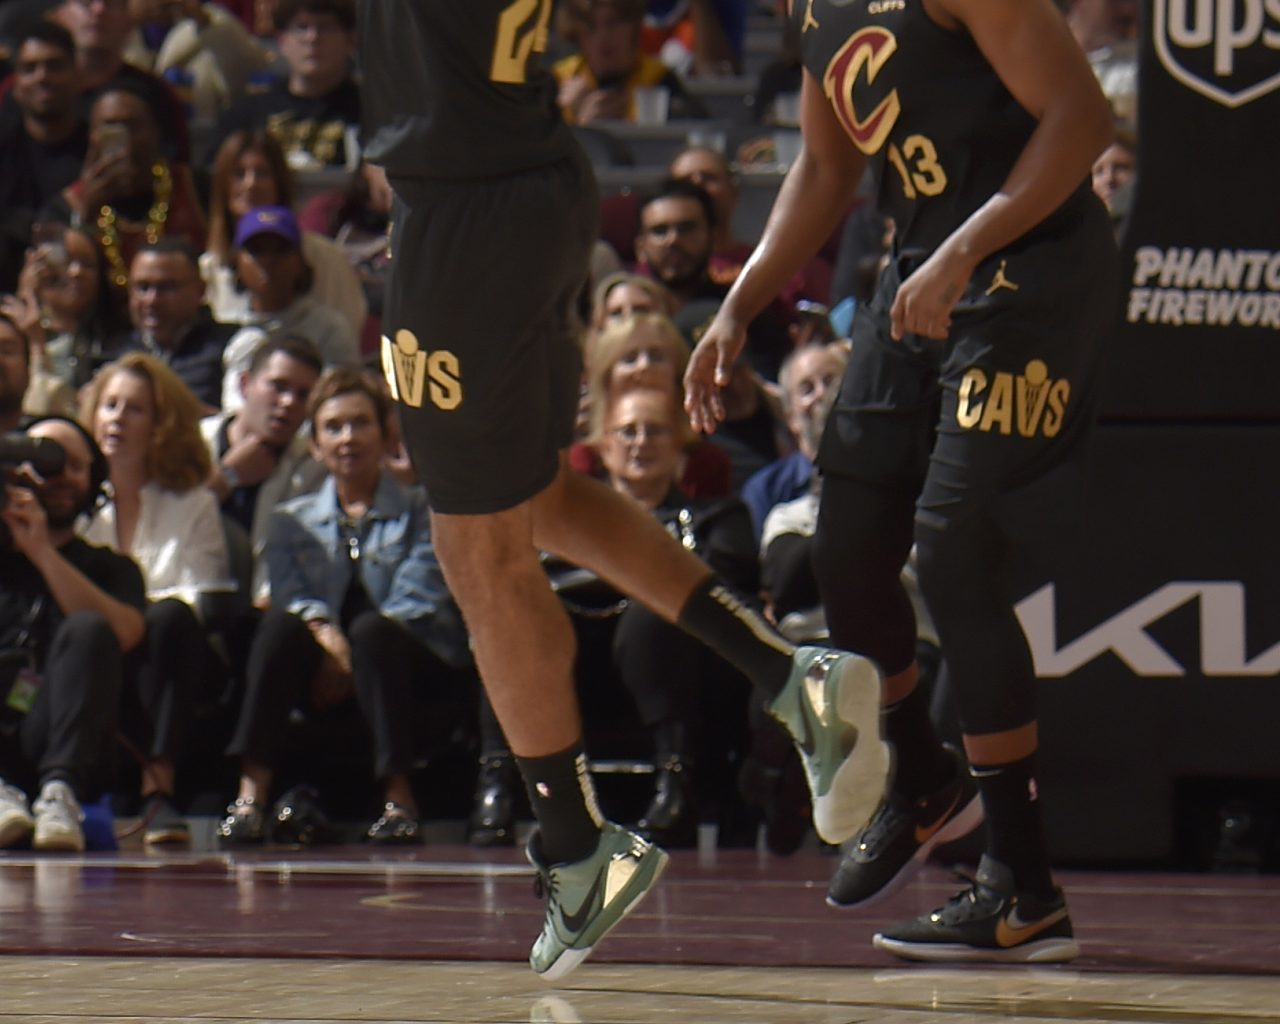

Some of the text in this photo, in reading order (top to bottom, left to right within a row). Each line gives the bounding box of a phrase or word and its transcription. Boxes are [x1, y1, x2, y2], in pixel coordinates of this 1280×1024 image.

[823, 26, 901, 156] C
[887, 134, 948, 200] 13
[957, 359, 1071, 439] CAVS
